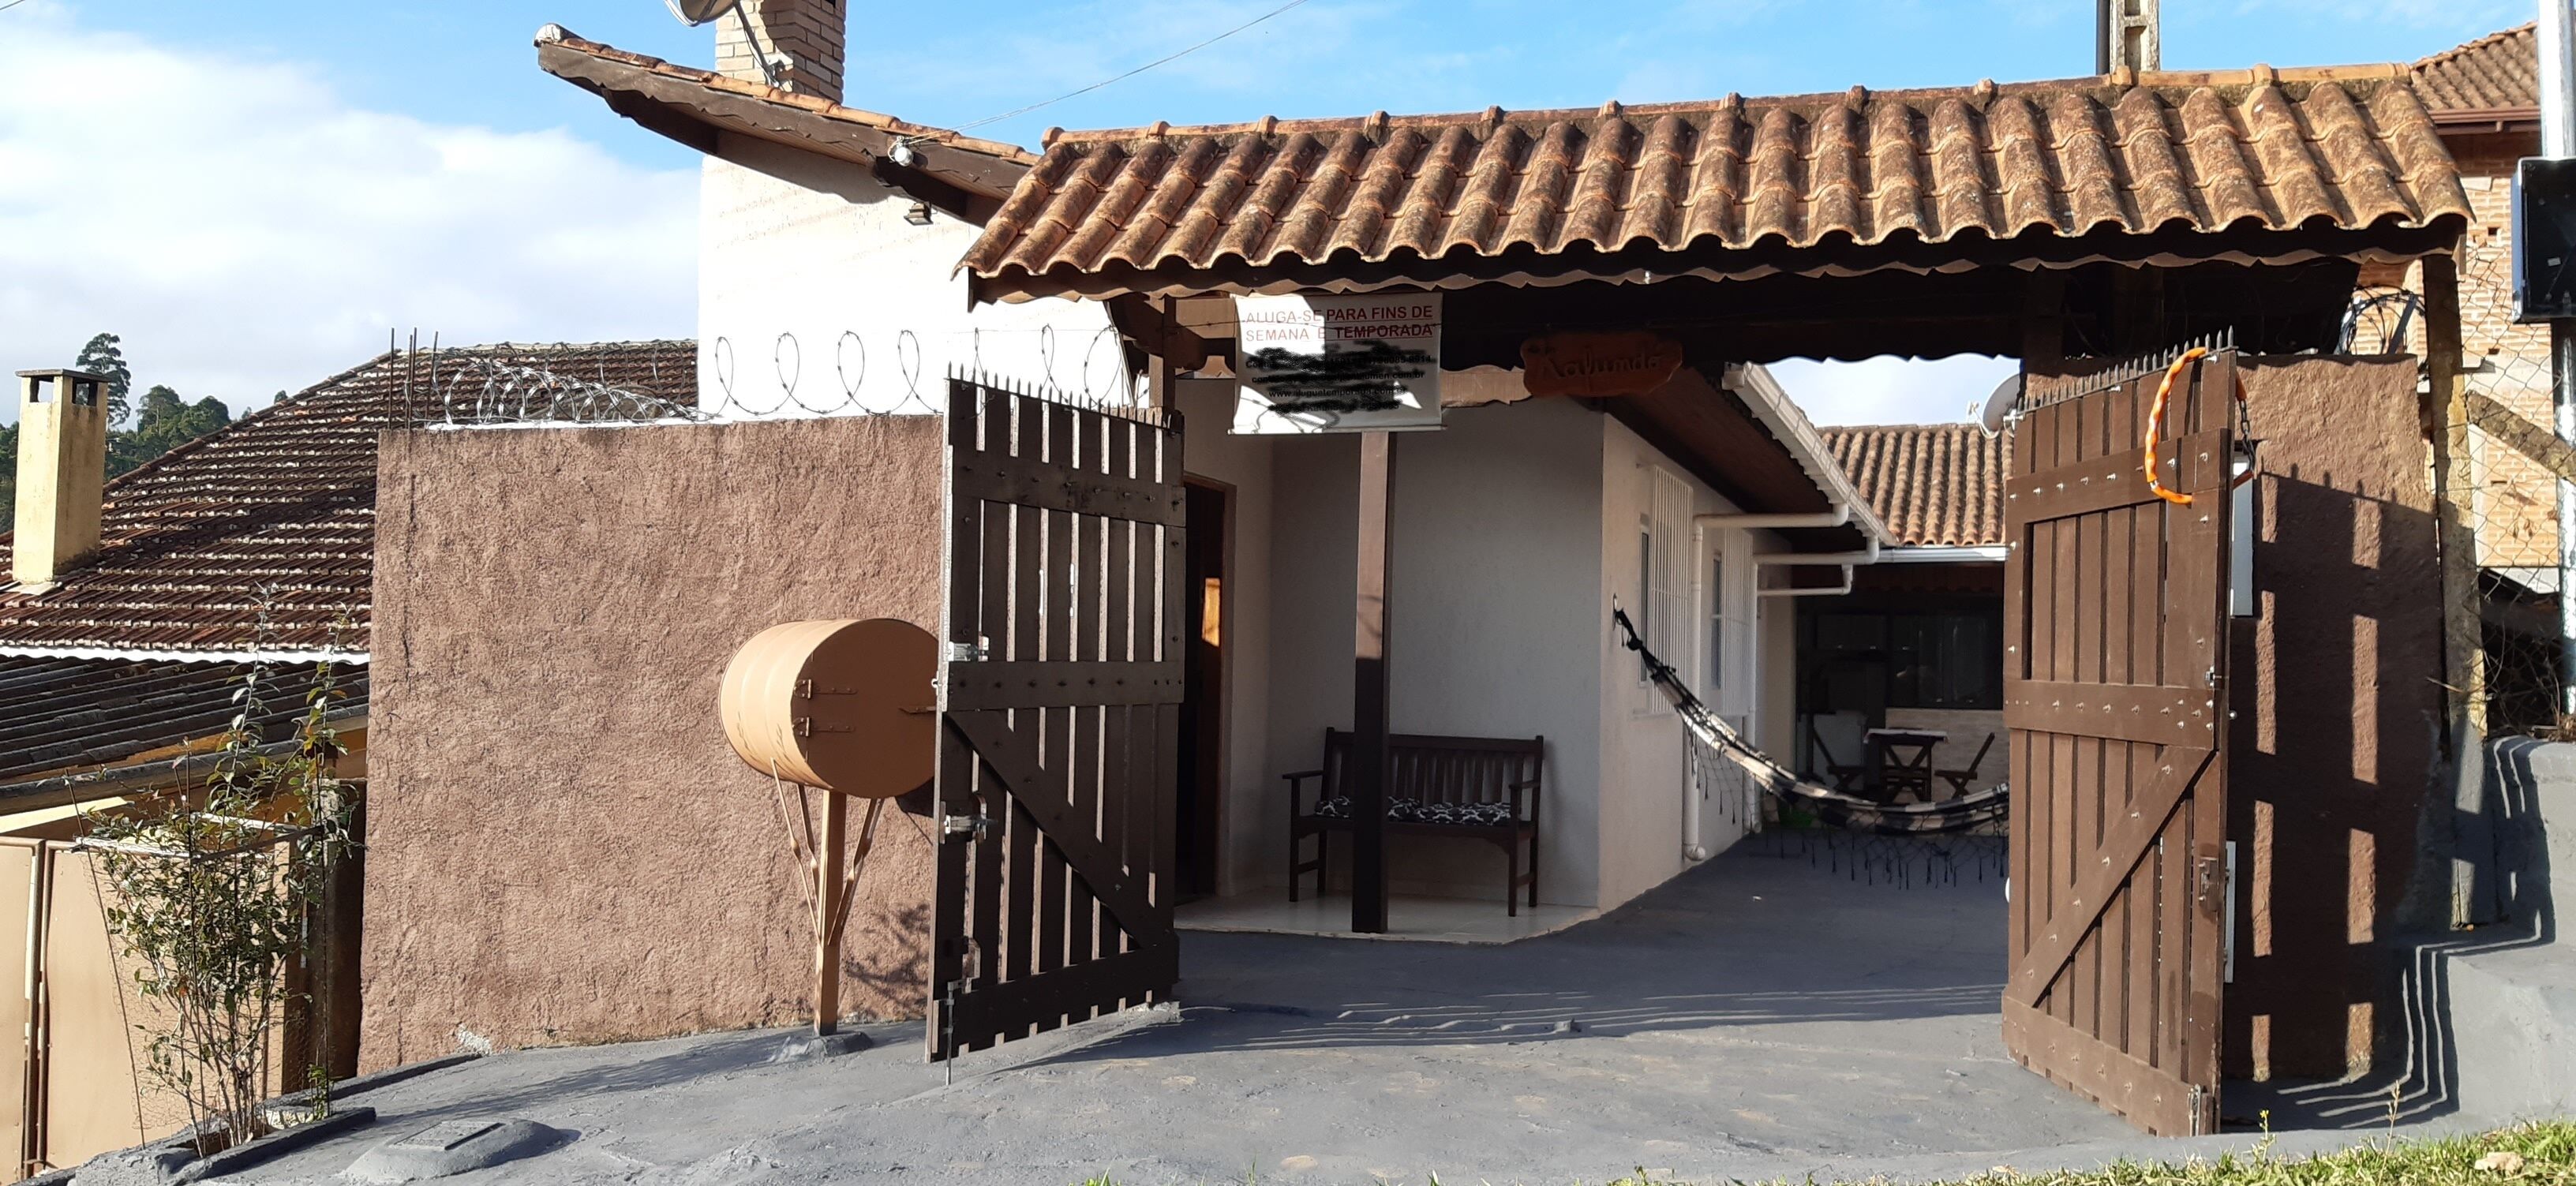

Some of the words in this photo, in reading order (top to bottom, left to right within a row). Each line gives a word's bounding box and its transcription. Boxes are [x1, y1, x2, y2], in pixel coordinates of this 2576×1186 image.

[1246, 310, 1322, 324] ALUGA-SE
[1326, 309, 1368, 320] PARA
[1372, 306, 1406, 320] FINS
[1411, 305, 1433, 318] DE
[1245, 328, 1309, 342] SEMANA
[1317, 327, 1326, 340] E
[1335, 324, 1433, 339] TEMPORADA
